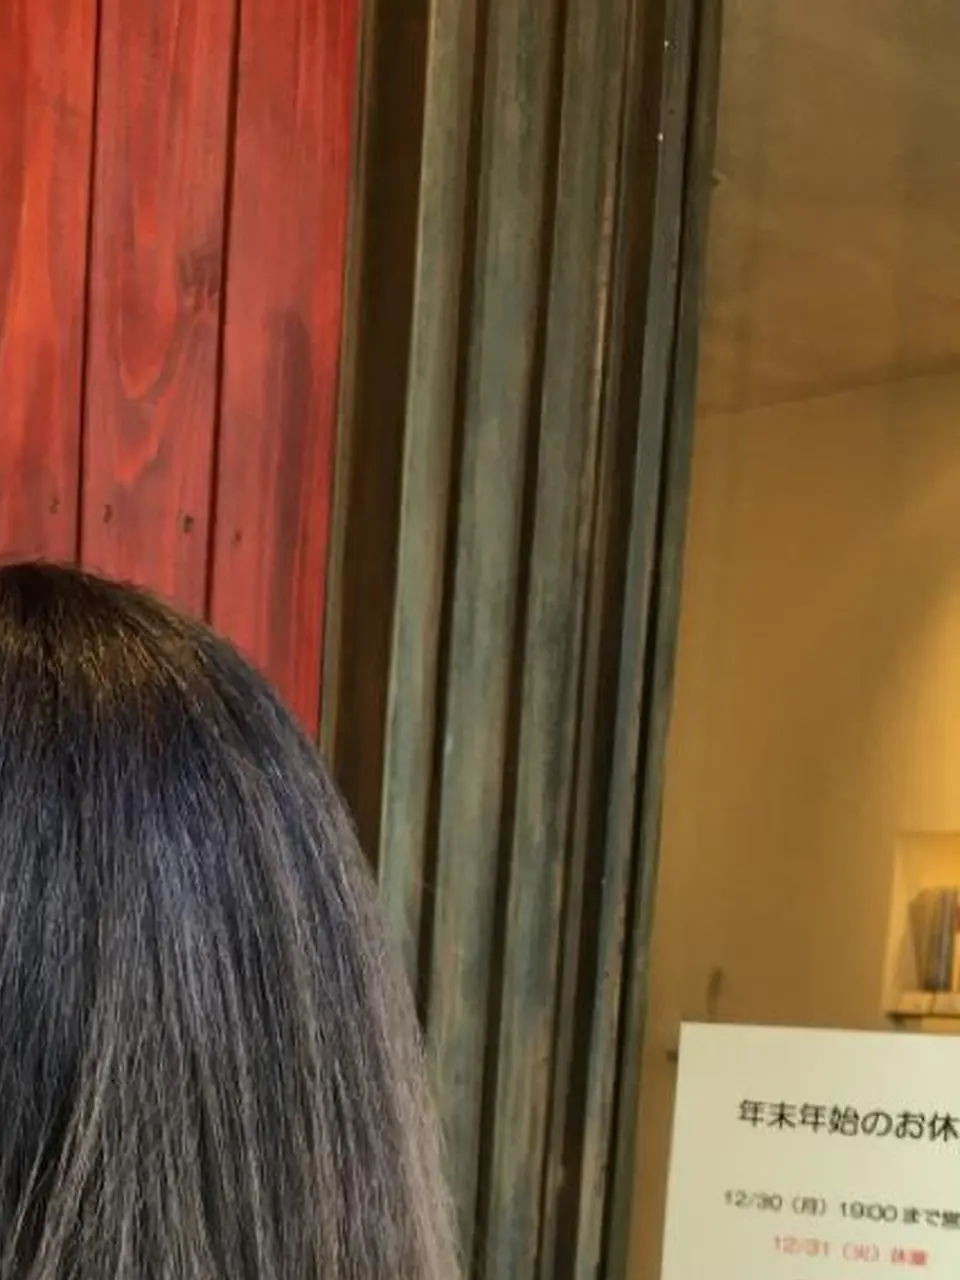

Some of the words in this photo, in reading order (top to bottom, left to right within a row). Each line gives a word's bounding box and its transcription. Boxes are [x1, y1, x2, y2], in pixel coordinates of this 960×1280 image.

[738, 1099, 959, 1142] 年末年始のお休
